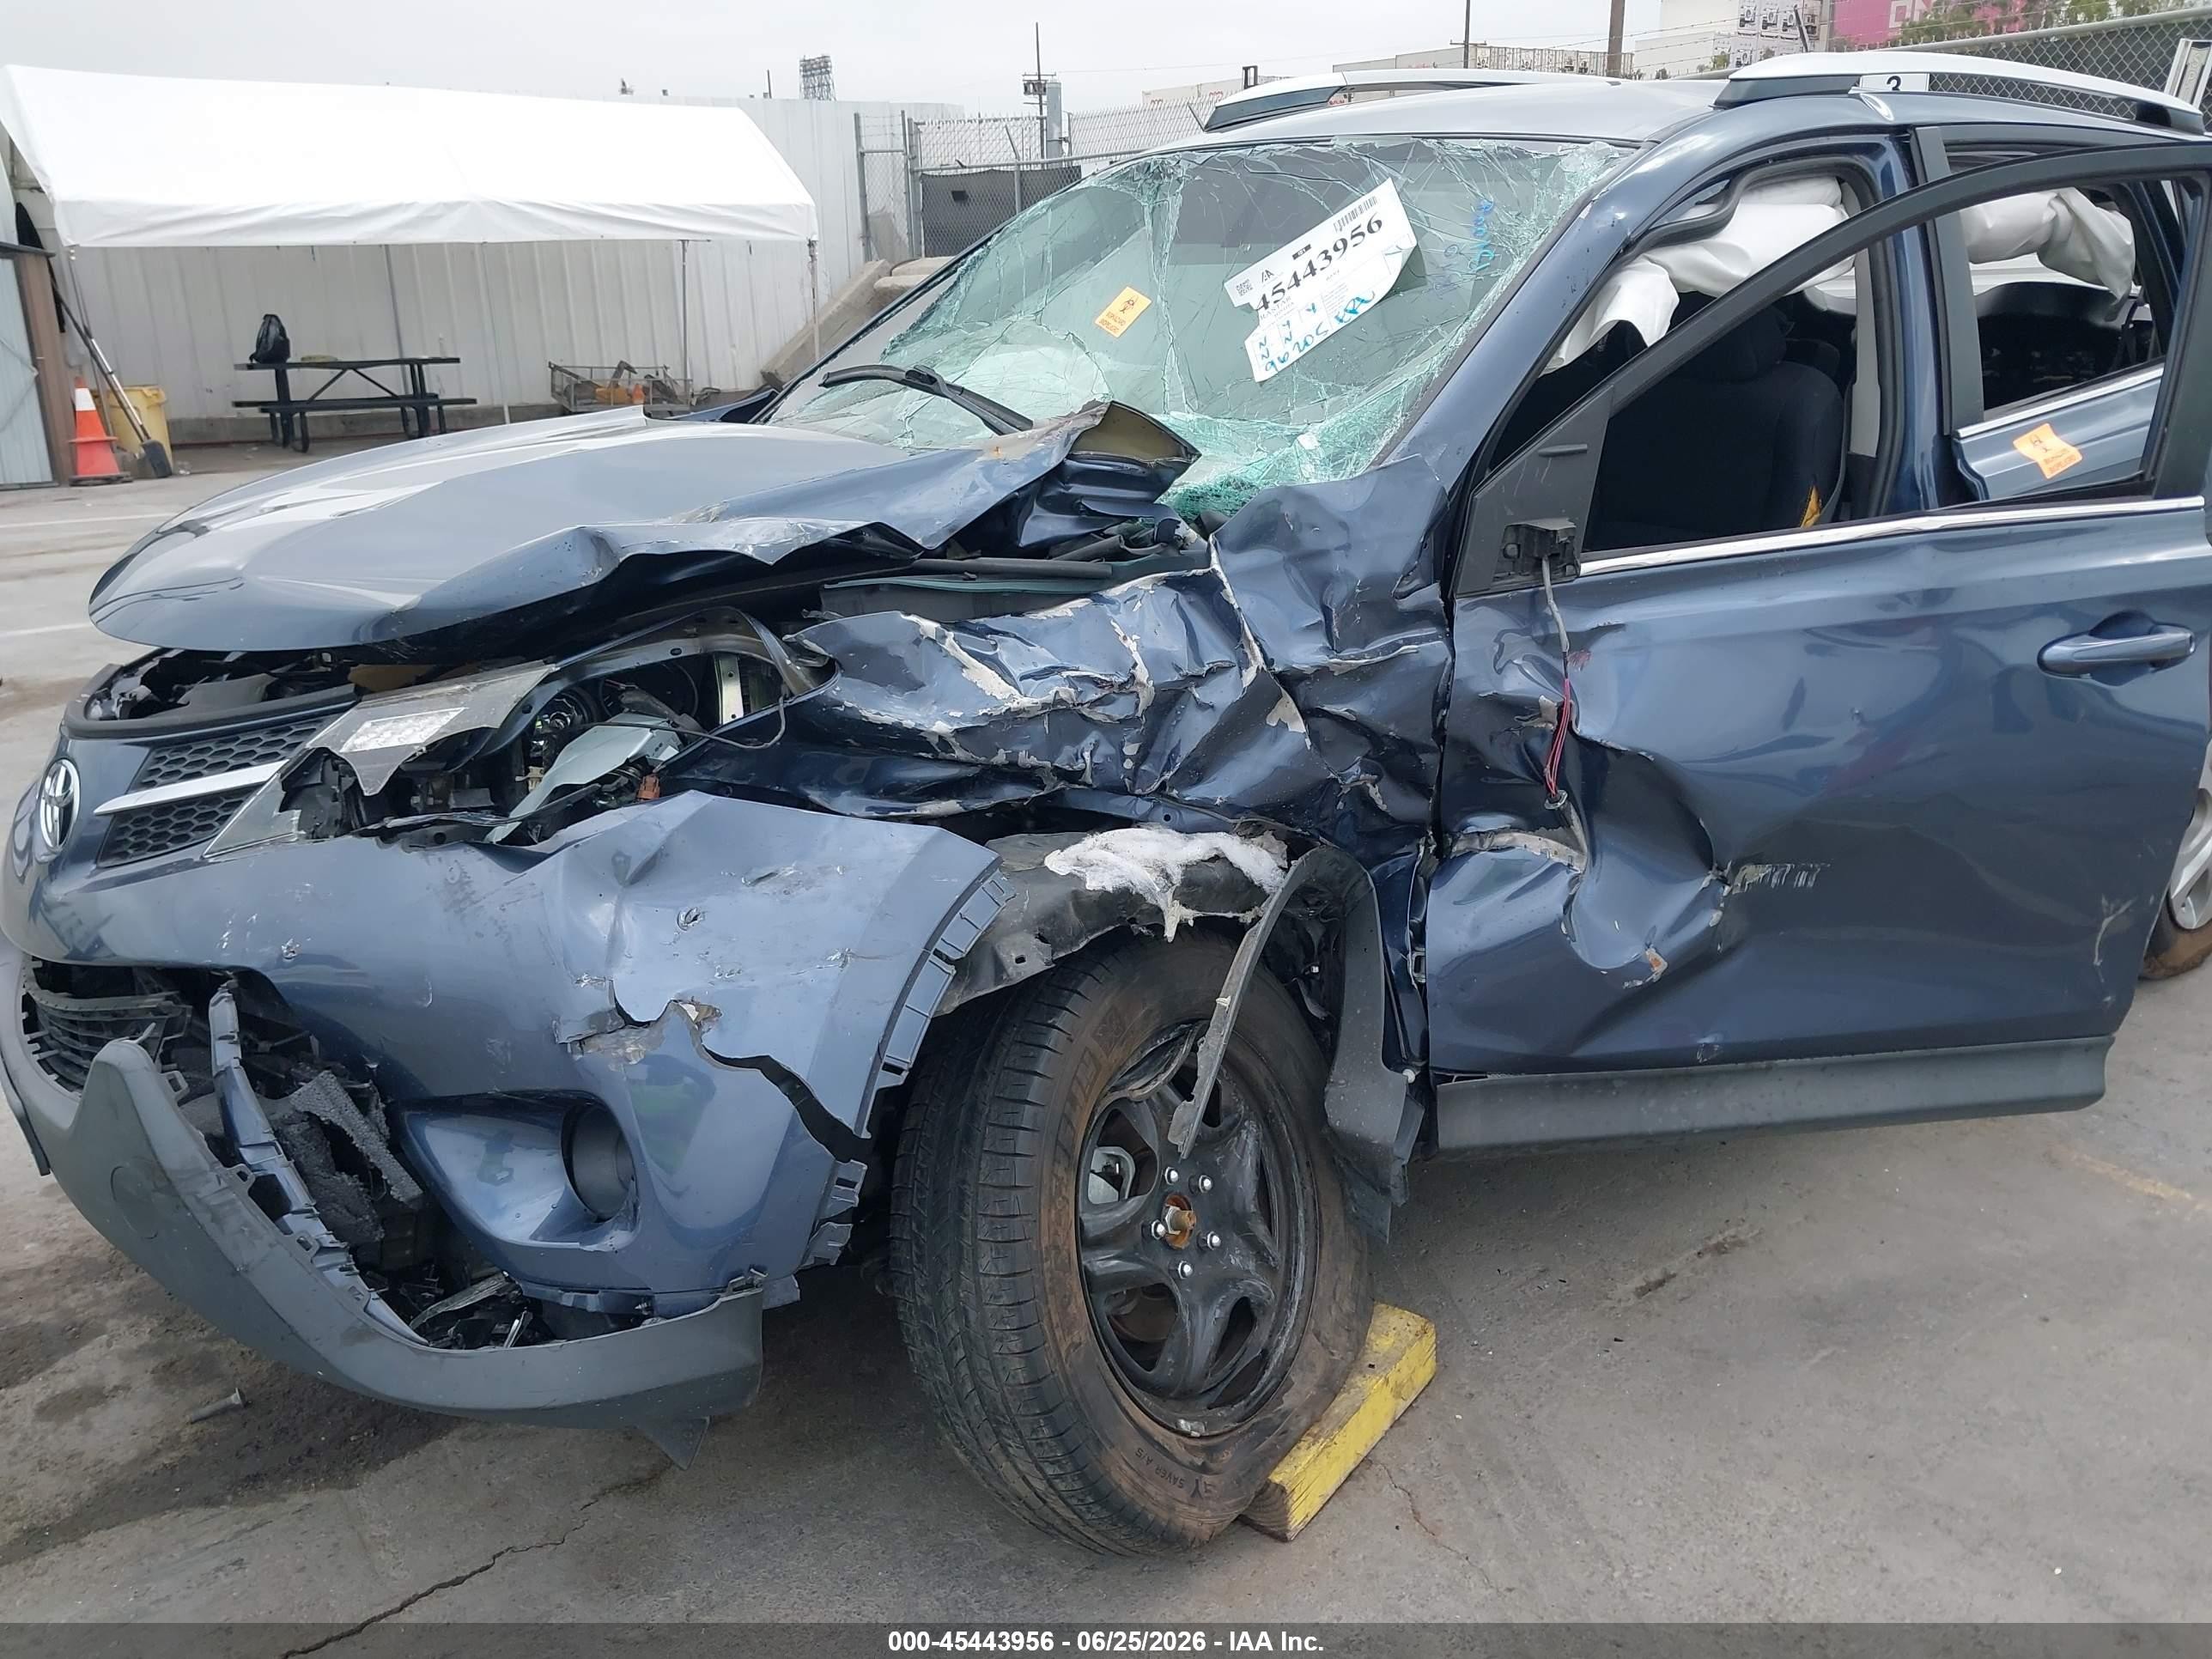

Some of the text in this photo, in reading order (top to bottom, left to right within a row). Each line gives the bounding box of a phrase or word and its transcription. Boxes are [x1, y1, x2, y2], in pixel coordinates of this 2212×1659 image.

[1256, 211, 1382, 310] 45443956
[1135, 1447, 1154, 1465] A/S
[1154, 1465, 1186, 1488] SAVER
